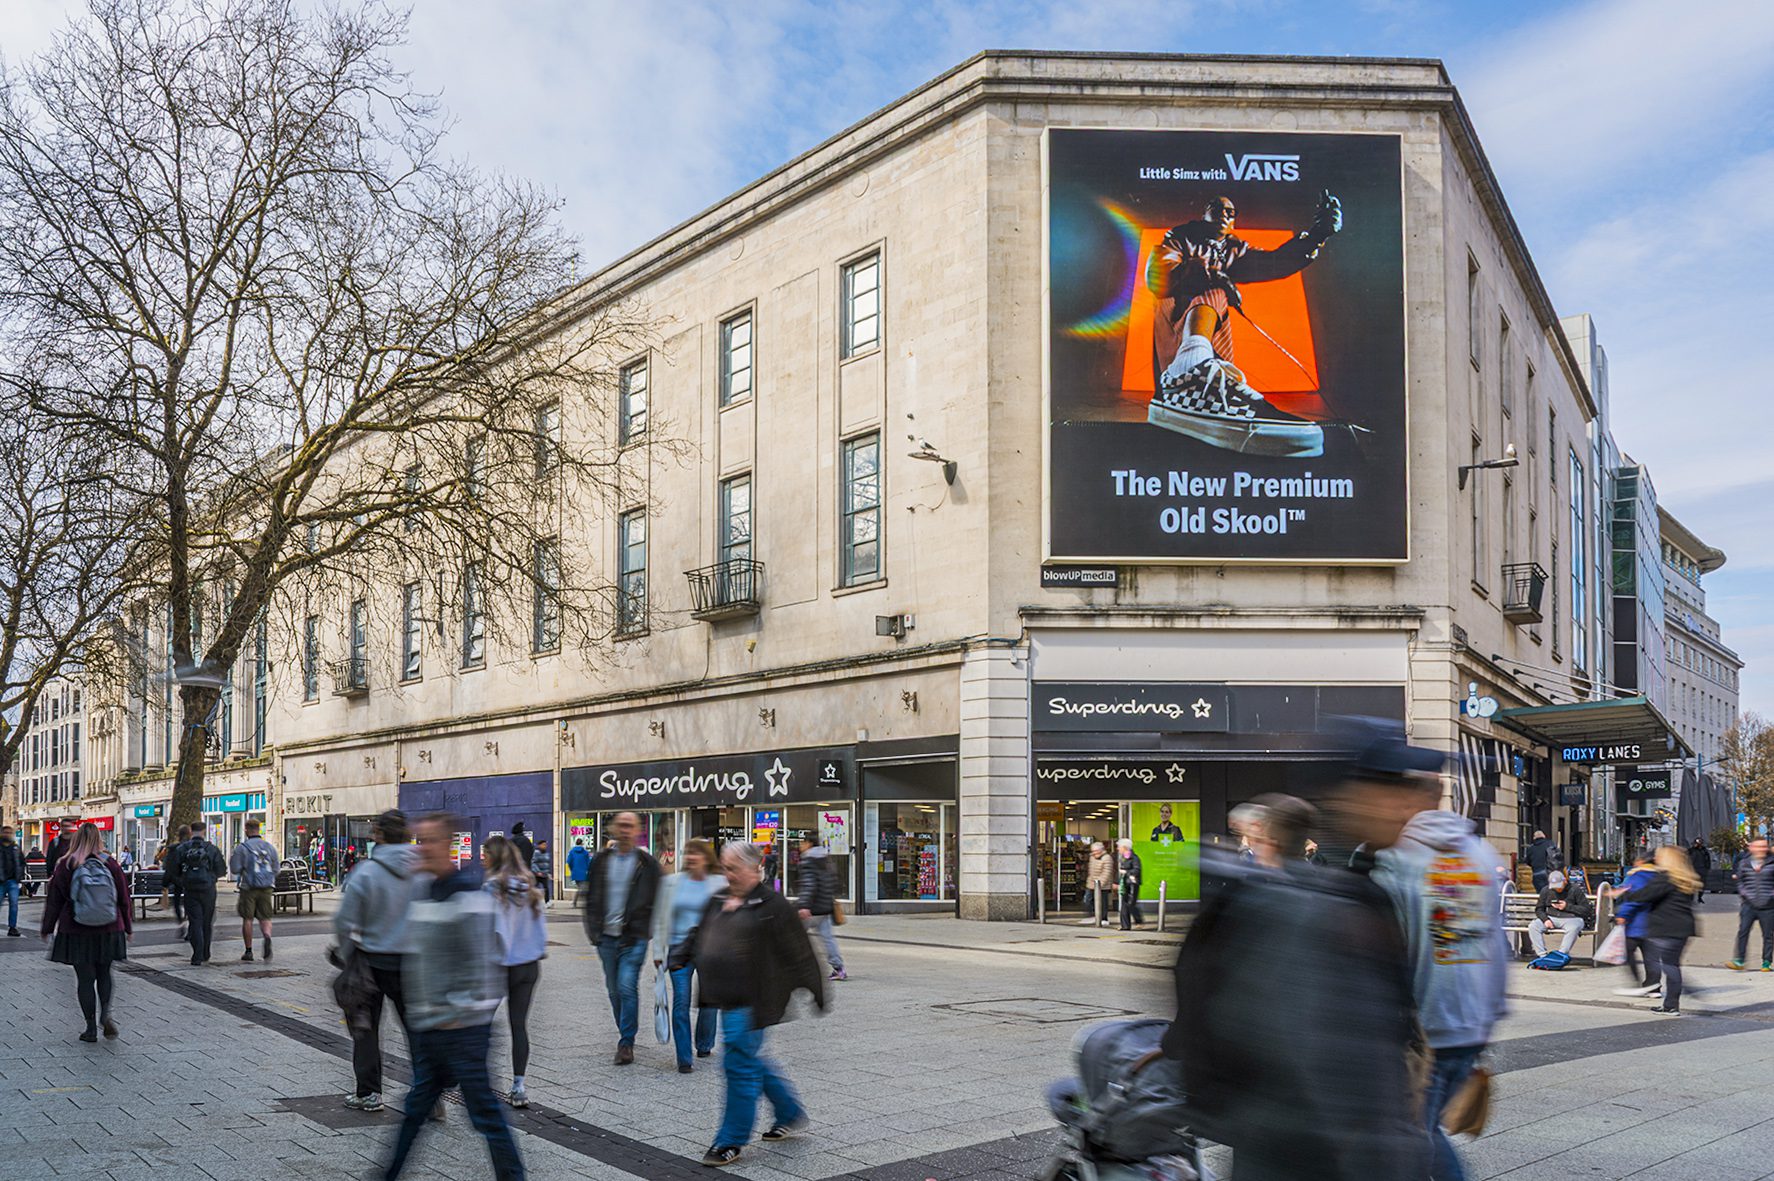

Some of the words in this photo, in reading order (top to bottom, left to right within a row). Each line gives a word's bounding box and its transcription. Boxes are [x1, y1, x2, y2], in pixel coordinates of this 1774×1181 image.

[1139, 167, 1171, 179] Little
[1172, 168, 1200, 180] Simz
[1201, 168, 1227, 180] with
[1224, 153, 1301, 182] VANS
[1111, 469, 1162, 496] The
[1168, 471, 1227, 497] New
[1233, 471, 1354, 498] Premium
[1159, 506, 1206, 533] Old
[1048, 697, 1184, 719] Superdrug
[1562, 747, 1597, 760] ROXY
[1599, 745, 1641, 760] LANES
[599, 766, 754, 803] Superdrug
[1036, 764, 1157, 784] uperdrug
[1645, 780, 1666, 789] GYMS
[286, 794, 333, 814] ROKIT
